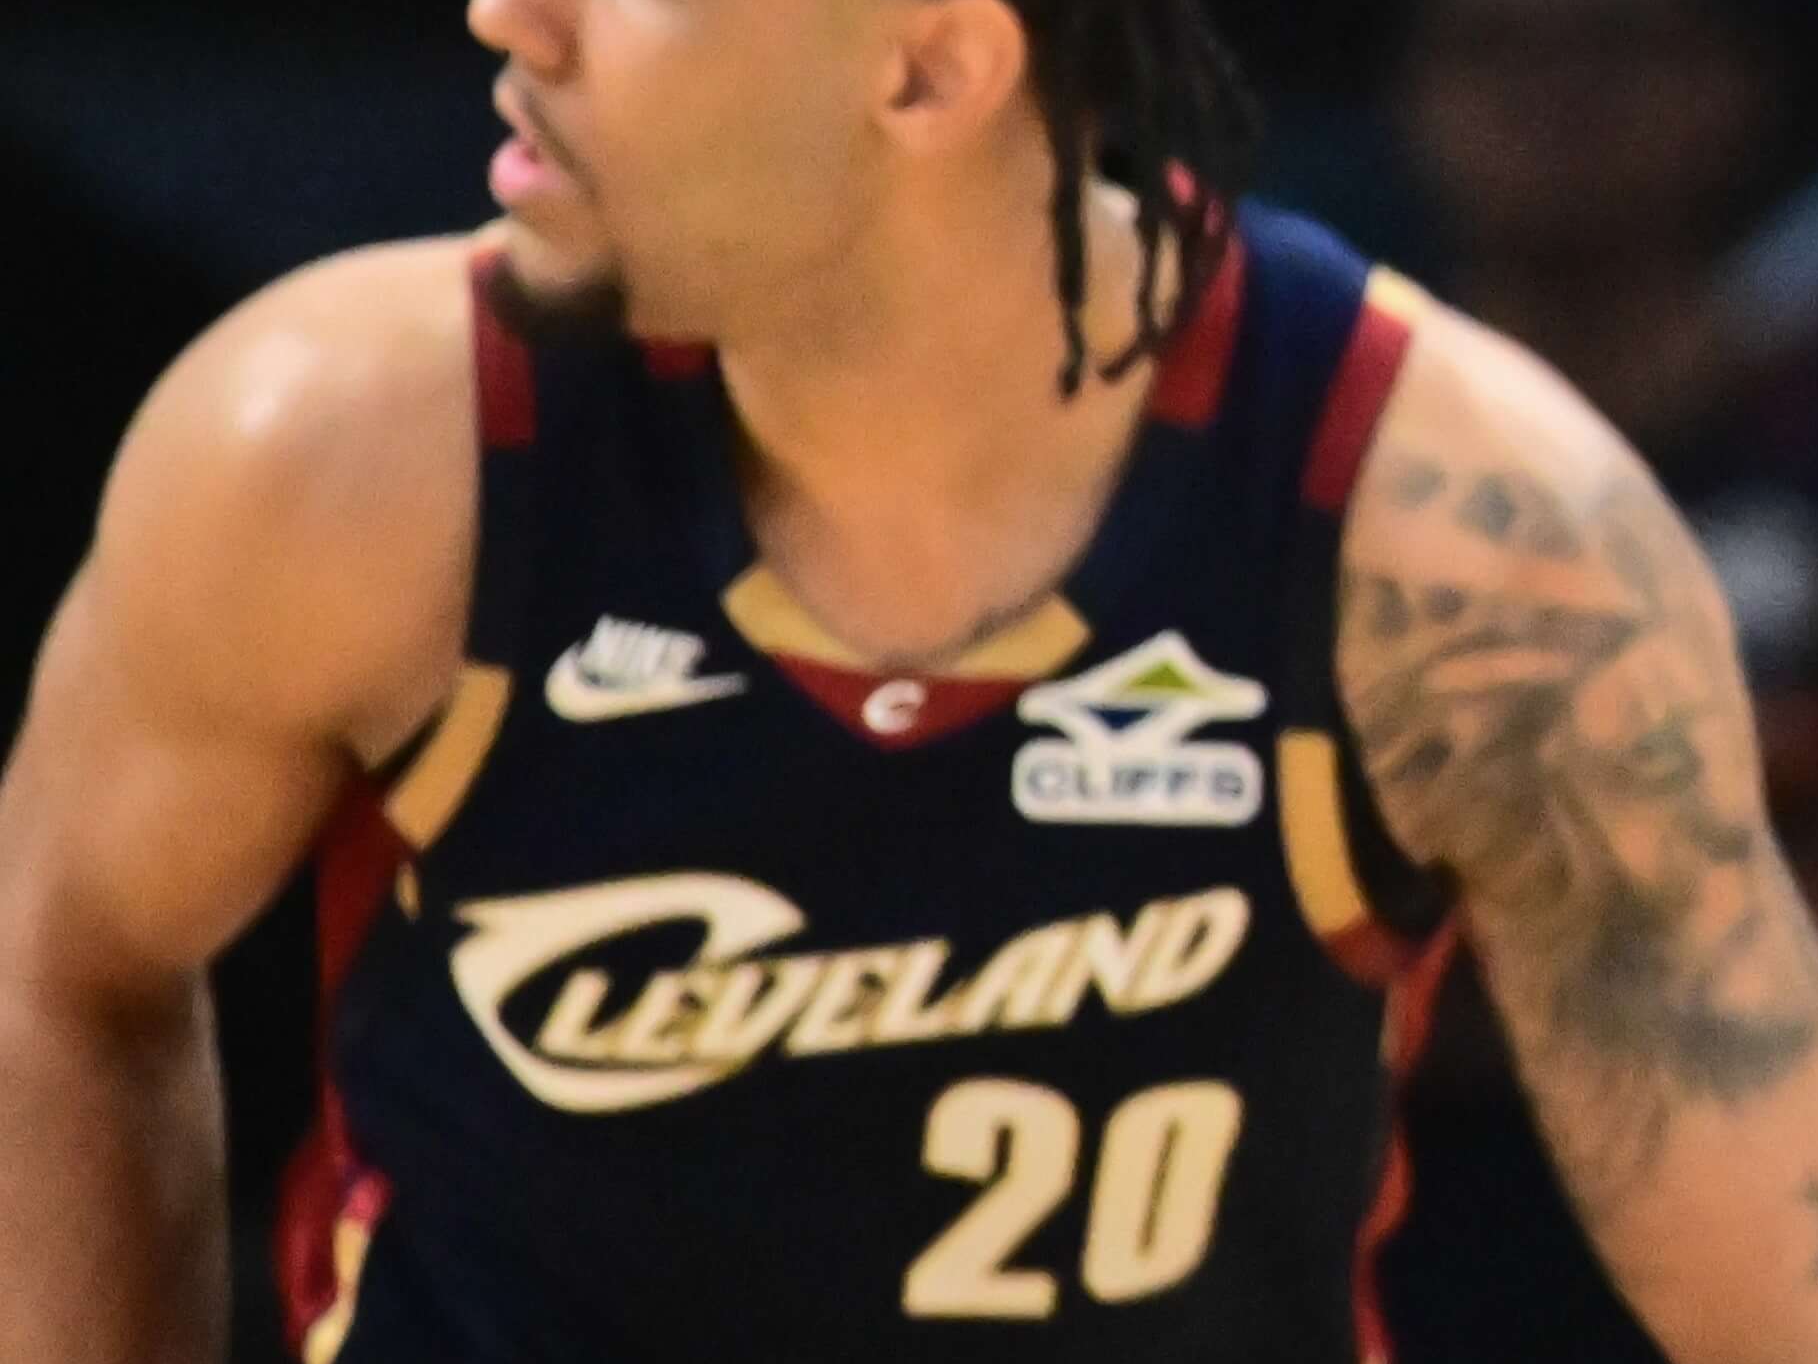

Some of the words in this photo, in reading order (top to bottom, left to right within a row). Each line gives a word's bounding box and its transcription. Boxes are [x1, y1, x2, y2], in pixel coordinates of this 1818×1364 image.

[1025, 759, 1246, 805] CLIFFS
[450, 871, 1252, 1115] CLEVELAND
[900, 1075, 1245, 1319] 20
